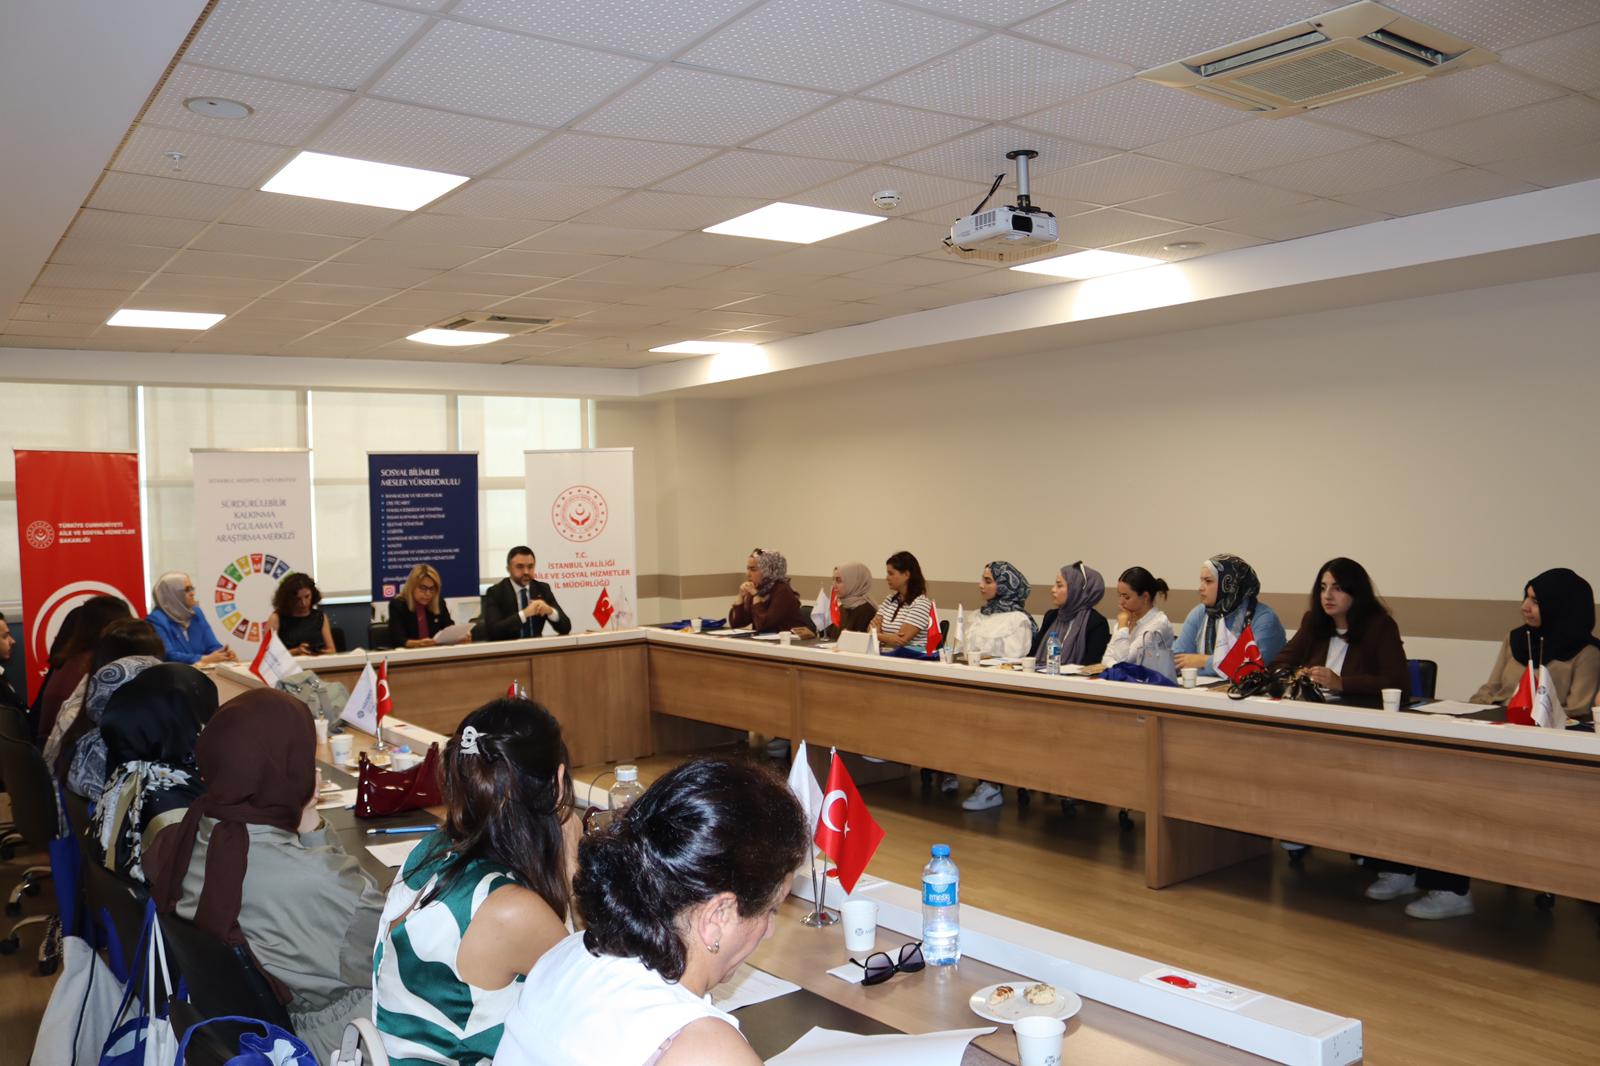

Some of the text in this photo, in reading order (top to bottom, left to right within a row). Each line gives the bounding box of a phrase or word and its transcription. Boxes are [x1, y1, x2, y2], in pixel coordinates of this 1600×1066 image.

[380, 466, 440, 477] SOSYAL BİLİMLER
[380, 477, 460, 487] MESLEK YÜKSEKOKULU
[221, 499, 287, 508] SÜRDÜRÜLEBİLİR
[233, 511, 275, 519] KALKINMA
[226, 520, 284, 531] UYGULAMA VE
[216, 531, 295, 543] ARAŞTIRMA MERKEZİ
[548, 559, 615, 570] İSTANBUL VALİLİĞİ
[561, 571, 588, 579] SOSYAL
[590, 568, 630, 577] HİZMETLER
[554, 579, 609, 589] İL MÜDÜRLÜĞÜ
